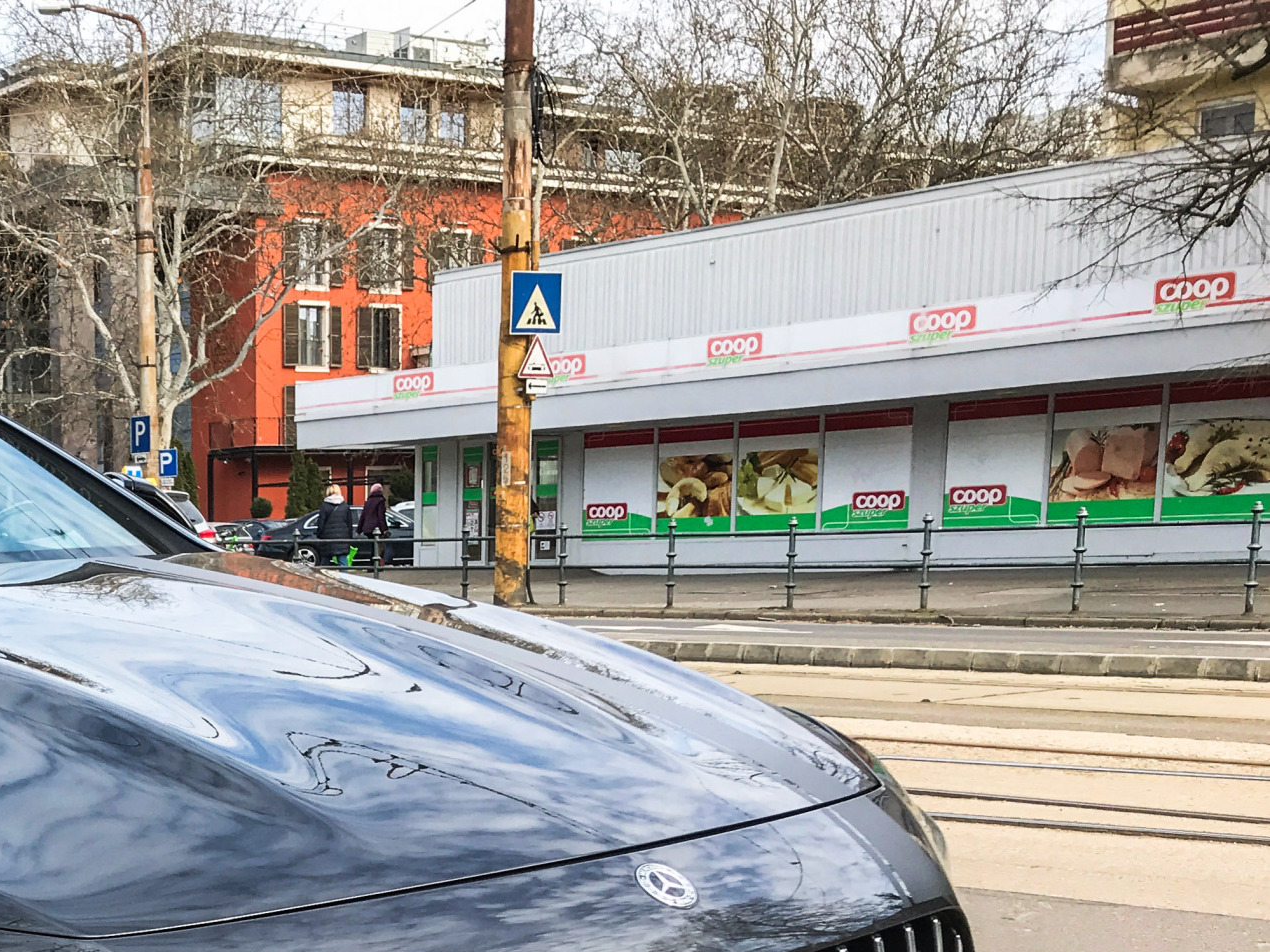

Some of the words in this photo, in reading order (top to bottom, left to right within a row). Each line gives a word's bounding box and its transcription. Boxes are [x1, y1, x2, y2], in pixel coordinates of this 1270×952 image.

[1159, 277, 1230, 301] coop
[1155, 298, 1209, 313] szuper
[913, 310, 972, 334] coop
[909, 327, 955, 344] szuper
[711, 336, 759, 359] coop
[550, 357, 583, 375] oop
[708, 353, 743, 367] szuper
[395, 373, 430, 392] coop
[135, 421, 146, 446] P
[160, 452, 172, 474] P
[855, 494, 902, 511] coop
[952, 488, 1004, 506] coop
[588, 505, 625, 521] coop
[851, 508, 887, 520] szuper
[948, 503, 987, 516] szuper
